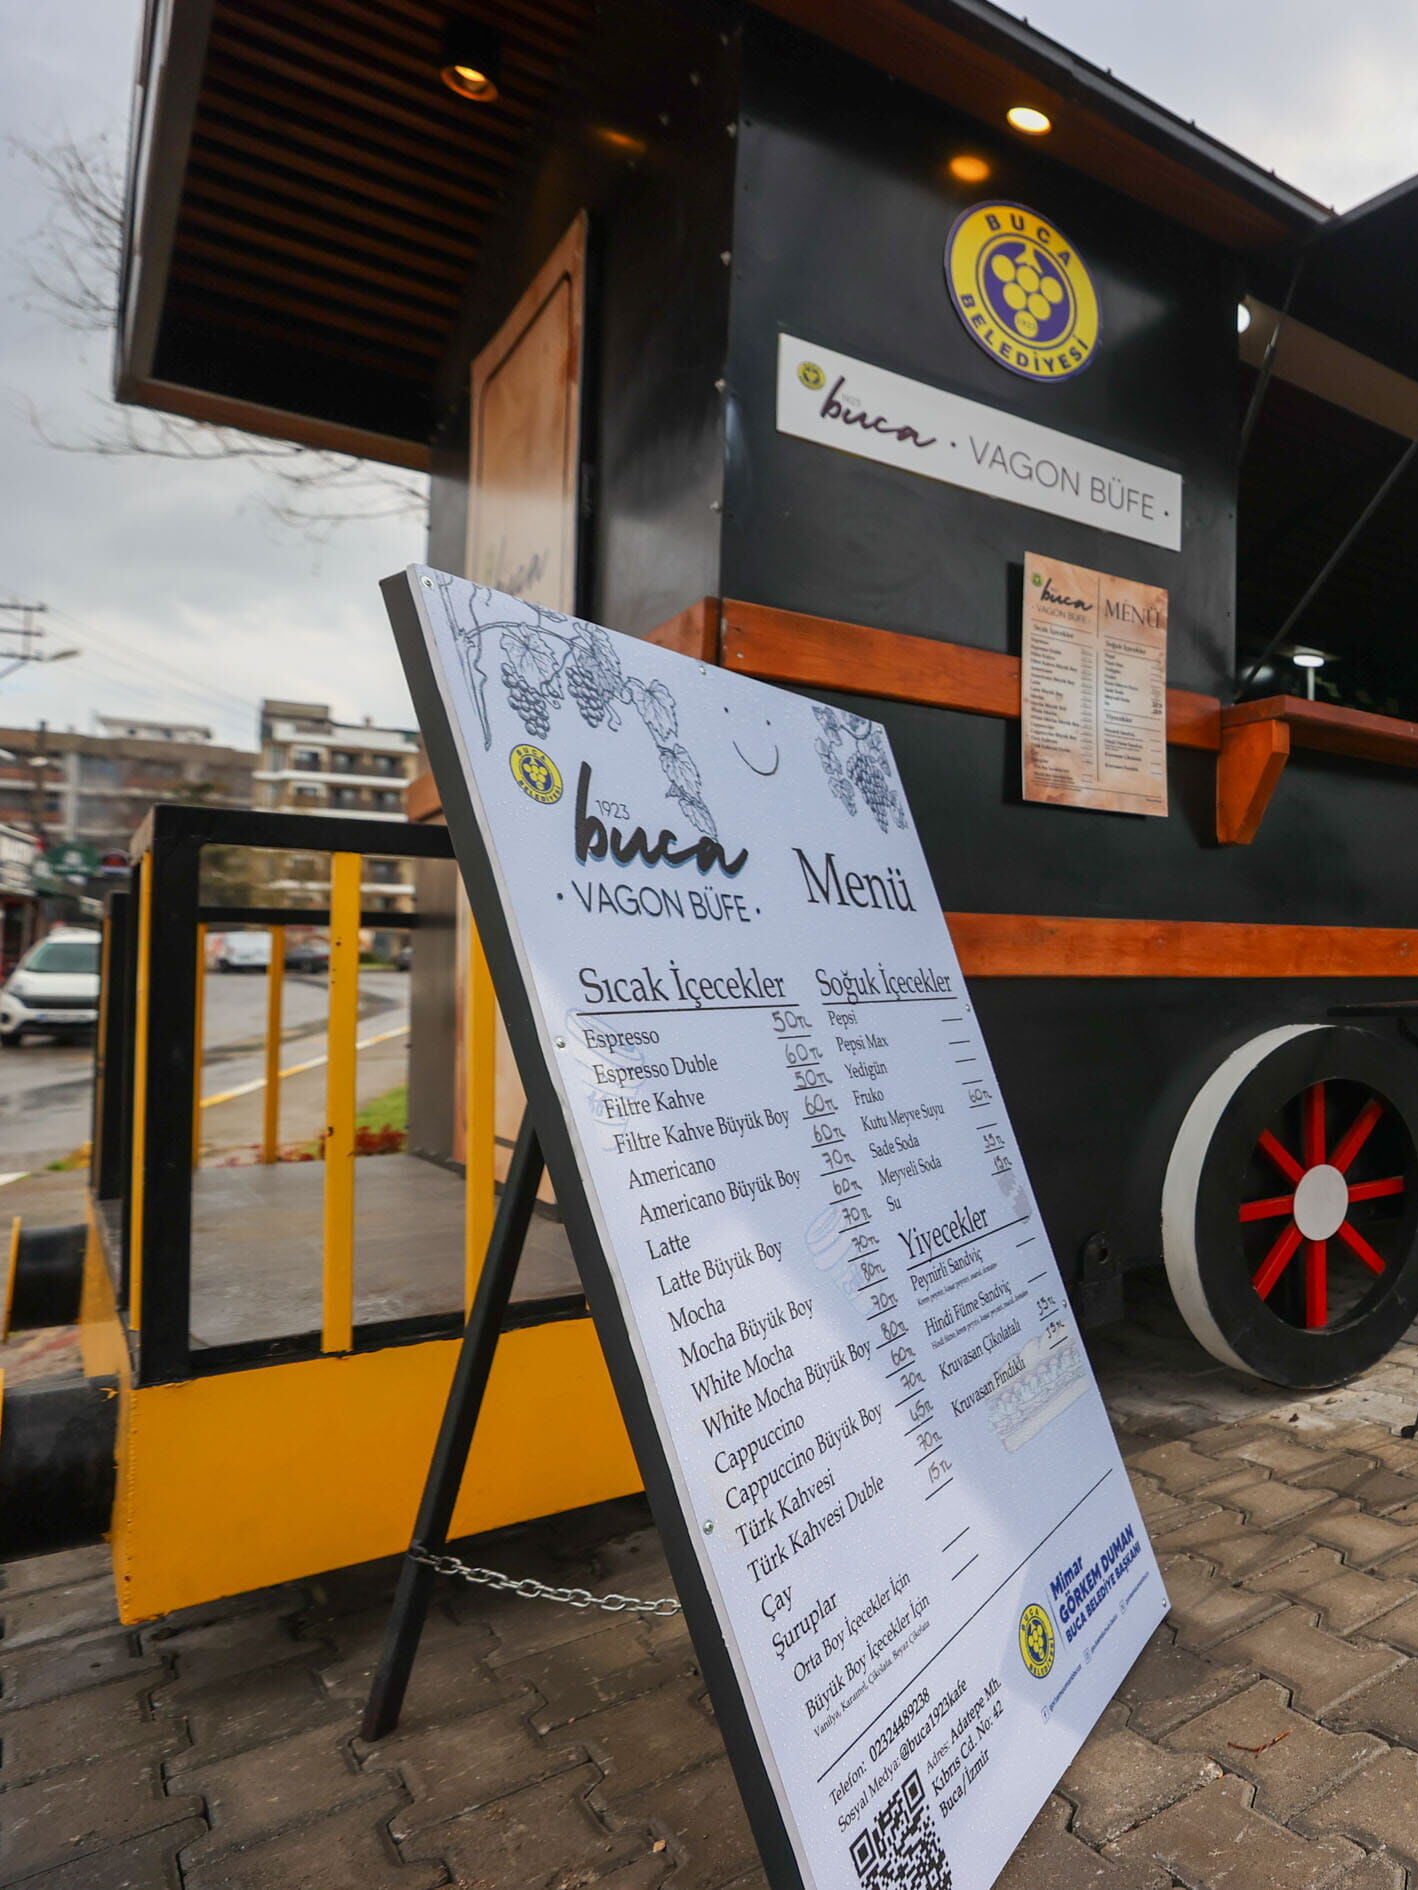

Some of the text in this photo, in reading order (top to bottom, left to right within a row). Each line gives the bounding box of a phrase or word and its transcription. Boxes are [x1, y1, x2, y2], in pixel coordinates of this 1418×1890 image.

[985, 213, 1071, 267] BUCA
[961, 294, 1088, 372] BELEDİYESİ
[821, 377, 1155, 520] buca VAGON BÜFE
[1041, 578, 1093, 611] buca
[1104, 599, 1160, 629] MENÜ
[574, 761, 749, 877] buca
[595, 800, 630, 820] 1923
[571, 880, 751, 922] VAGON BÜFE
[792, 848, 917, 913] Menü
[578, 960, 786, 1008] Sıcak İçecekler
[815, 962, 952, 1004] Soğuk İçecekler
[582, 1029, 660, 1053] Espresso
[827, 1010, 858, 1030] Pepsi
[836, 1033, 889, 1055] Pepsi Max
[593, 1053, 719, 1088] Espresso Duble
[844, 1062, 889, 1081] Yedigün
[852, 1088, 885, 1105] Fruko
[603, 1090, 706, 1120] Filtre Kahve
[613, 1108, 789, 1155] Filtre Kahve Büyük Boy
[860, 1103, 945, 1132] Kutu Meyve Suyu
[628, 1157, 716, 1189] Americano
[868, 1133, 920, 1159] Sade Soda
[877, 1155, 942, 1186] Meyveli Soda
[639, 1169, 801, 1225] Americano Büyük Boy
[886, 1195, 902, 1212] Su
[645, 1234, 691, 1260] Latte
[898, 1206, 989, 1262] Yiyecekler
[657, 1241, 782, 1296] Latte Büyük Boy
[910, 1261, 948, 1292] Peynirli
[947, 1247, 983, 1274] Sandviç
[667, 1297, 727, 1332] Mocha
[679, 1298, 814, 1368] Mocha Büyük Boy
[924, 1308, 954, 1337] Hindi
[952, 1298, 980, 1322] Füme
[978, 1280, 1012, 1306] Sandviç
[691, 1344, 794, 1403] White Mocha
[938, 1317, 1022, 1379] Kruvasan Çikolatalı
[702, 1340, 872, 1439] White Mocha Büyük Boy
[951, 1355, 1027, 1417] Kruvasan Fındıklı
[714, 1413, 805, 1474] Cappuccino
[725, 1404, 883, 1510] Cappuccino Büyük Boy
[735, 1468, 836, 1547] Türk Kahvesi
[747, 1476, 885, 1583] Türk Kahvesi Duble
[1049, 1554, 1084, 1602] Mimar
[1058, 1563, 1102, 1624] GÖRKEM
[1101, 1523, 1135, 1574] DUMAN
[1065, 1612, 1087, 1644] BUCA
[1085, 1573, 1117, 1620] BELEDİYE
[1115, 1542, 1142, 1580] BAŞKANI
[761, 1585, 793, 1622] Çay
[771, 1593, 838, 1661] Şuruplar
[793, 1571, 911, 1682] Orta Boy İçecekler İçin
[805, 1595, 931, 1719] Büyük Boy İçecekler İçin
[830, 1687, 931, 1806] Telefon: 02324489238
[926, 1677, 1002, 1774] Adres: Adatepe Mh.
[931, 1700, 1004, 1797] Kıbrıs Cd. No: 42
[837, 1679, 968, 1833] Sosyal Medya: @buca1923kafe
[938, 1748, 991, 1819] Buca/İzmir
